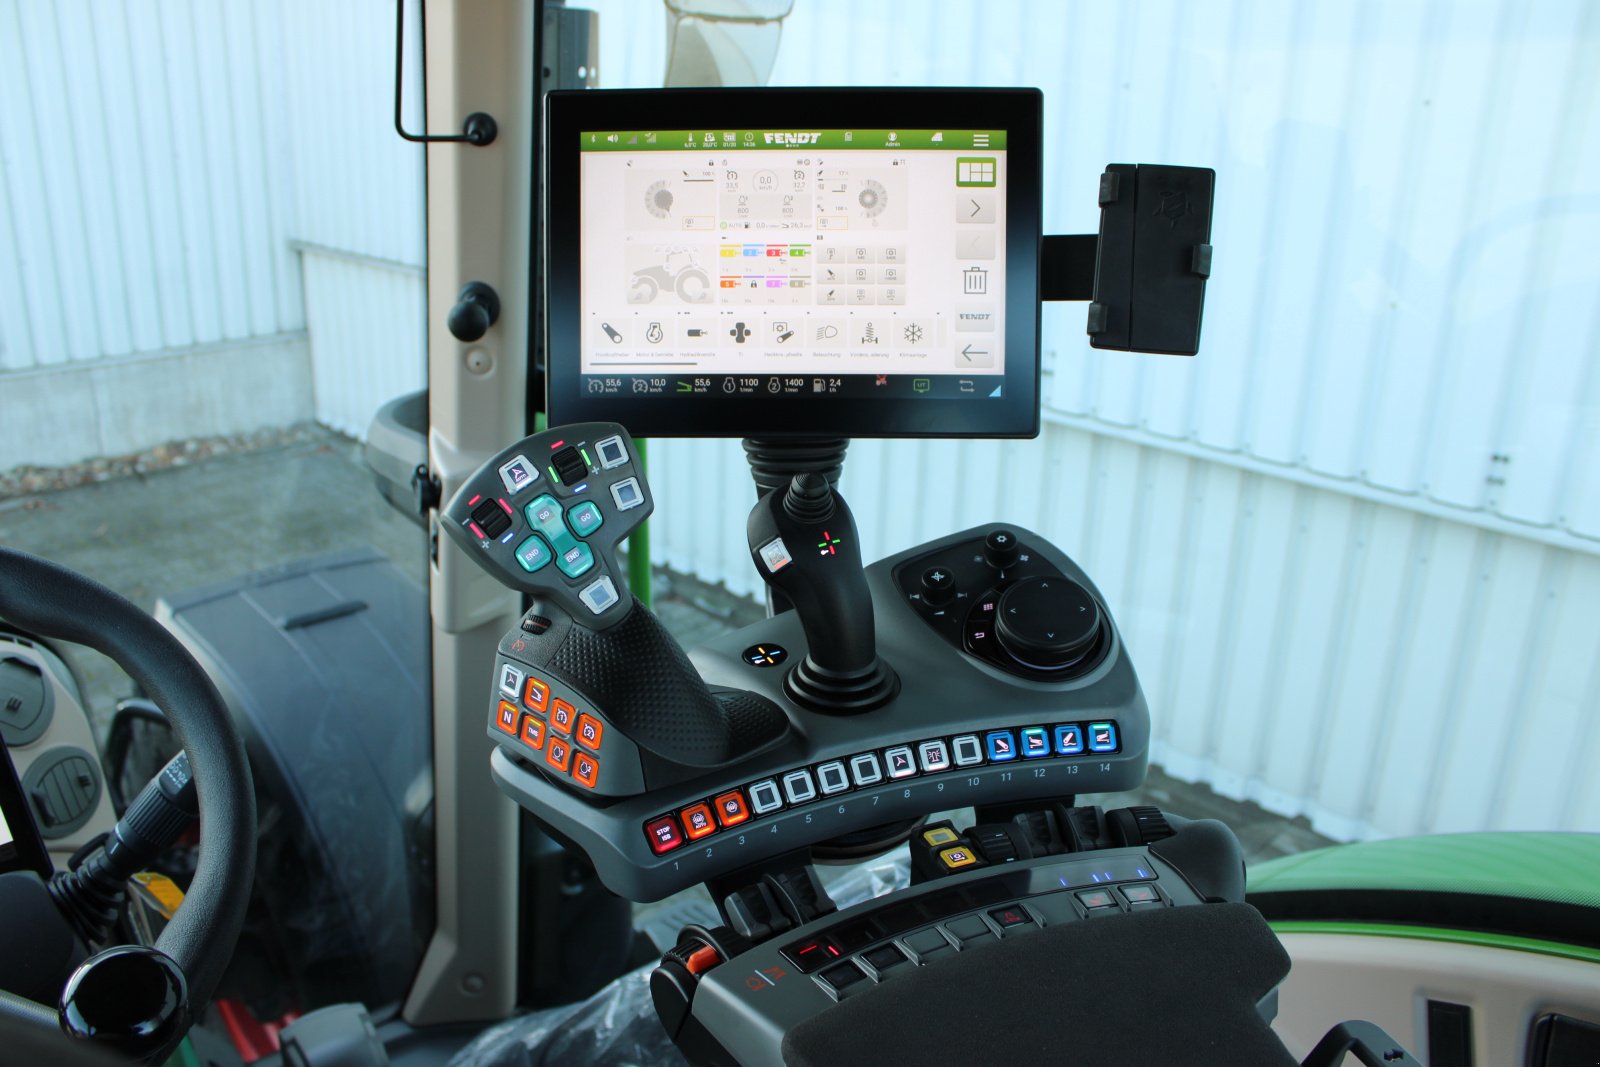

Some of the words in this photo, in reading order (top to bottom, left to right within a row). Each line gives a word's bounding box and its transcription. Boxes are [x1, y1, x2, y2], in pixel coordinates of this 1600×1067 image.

[763, 132, 822, 144] FENDT
[759, 176, 772, 185] 0,0
[605, 378, 622, 387] 55,6
[650, 378, 666, 387] 10,0
[694, 378, 711, 387] 55,6
[740, 378, 759, 387] 1100
[784, 378, 804, 387] 1400
[829, 378, 841, 387] 2,4
[539, 510, 550, 521] GO
[580, 512, 592, 523] GO
[525, 548, 539, 561] END
[565, 550, 580, 563] END
[503, 710, 512, 724] N
[1067, 765, 1079, 775] 13
[1100, 762, 1111, 772] 14
[1001, 773, 1012, 782] 11
[1033, 768, 1046, 778] 12
[967, 777, 980, 787] 10
[937, 783, 944, 792] 9
[904, 789, 911, 799] 8
[872, 796, 879, 806] 7
[838, 804, 845, 814] 6
[805, 814, 812, 824] 5
[656, 825, 671, 836] STOP
[770, 824, 778, 834] 4
[738, 835, 746, 845] 3
[705, 848, 713, 858] 2
[673, 861, 679, 871] 1
